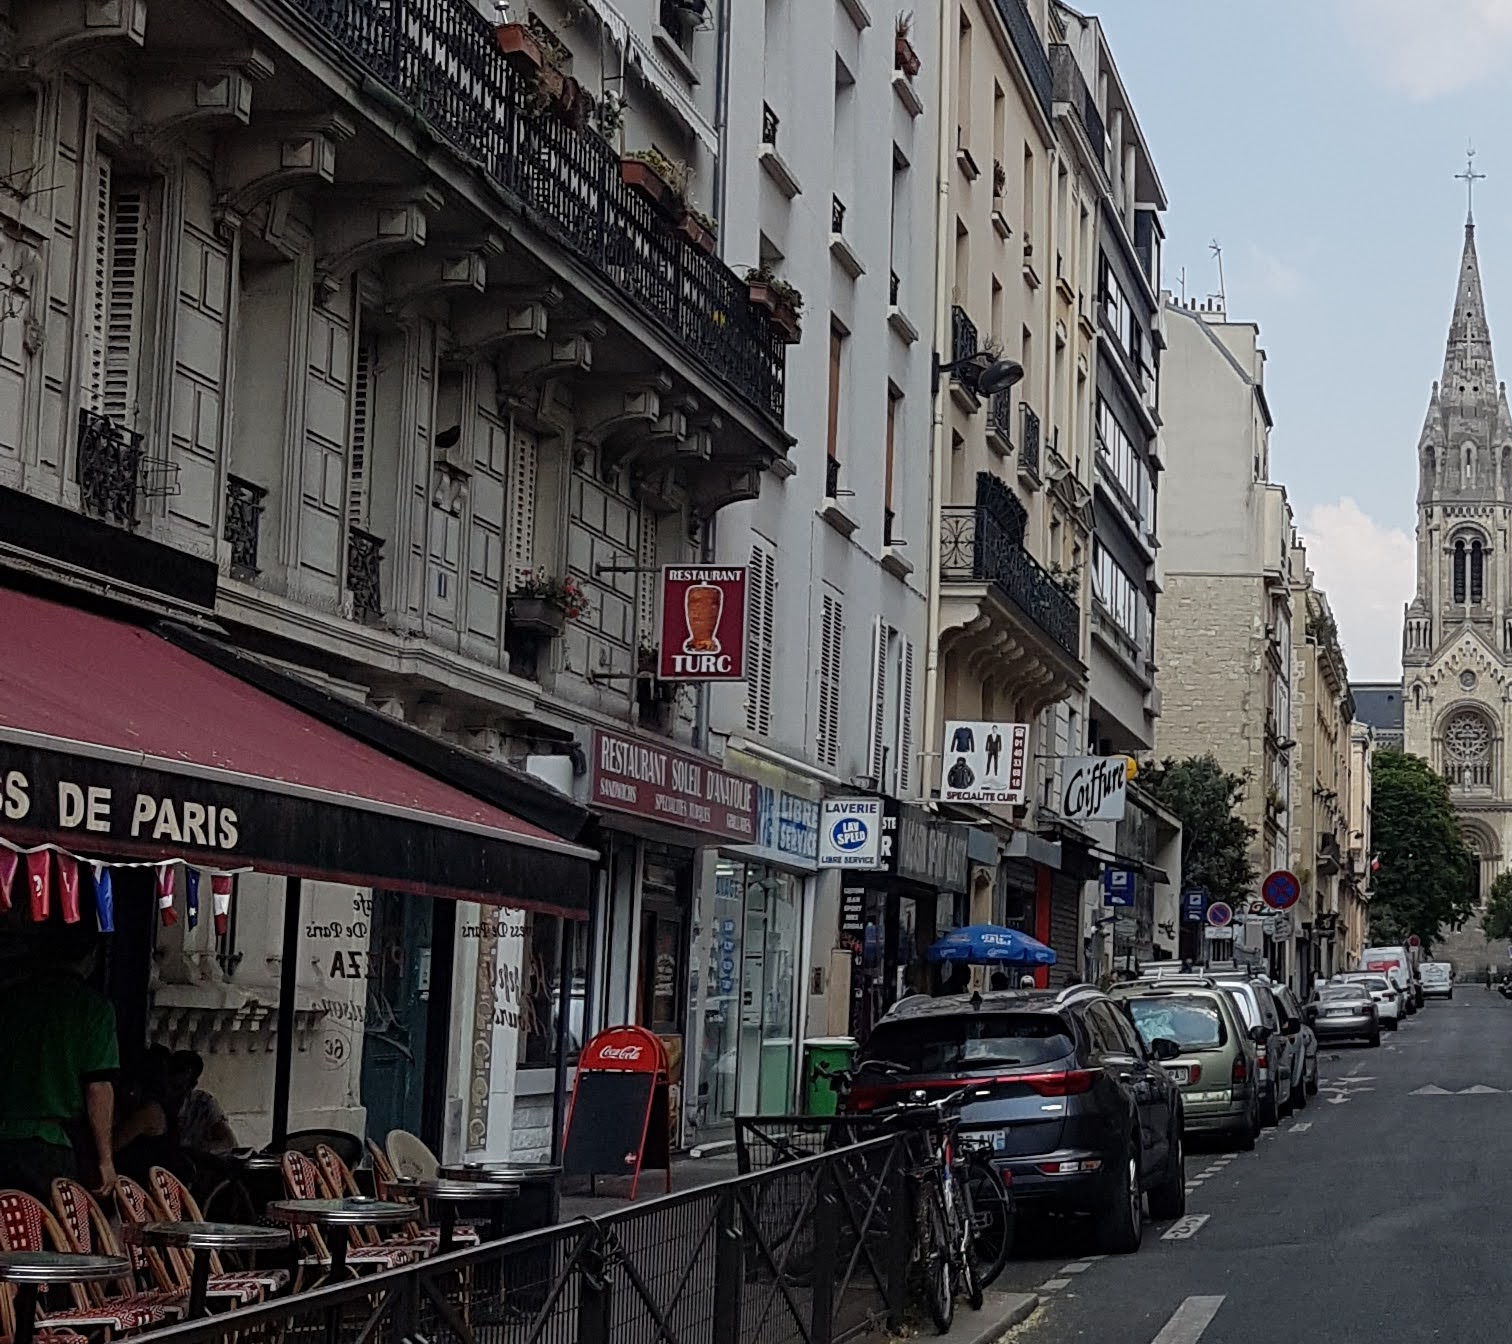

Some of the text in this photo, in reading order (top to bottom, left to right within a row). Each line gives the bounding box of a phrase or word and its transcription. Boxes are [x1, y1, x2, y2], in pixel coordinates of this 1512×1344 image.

[669, 570, 742, 581] RESTAURANT
[672, 655, 732, 673] TURC
[601, 736, 752, 812] RESTAURANT SOLEIL D'ANATOLIE
[1064, 760, 1124, 816] Coiffure
[946, 792, 1018, 802] SPECIALITE CUIR
[0, 770, 238, 850] S DE PARIS
[781, 794, 818, 828] LIBRE
[825, 803, 877, 814] LAVERIE
[843, 821, 859, 833] LAV
[780, 822, 817, 856] SERVICE
[836, 831, 866, 845] SPEED
[821, 855, 874, 864] LIBRE SERVICE
